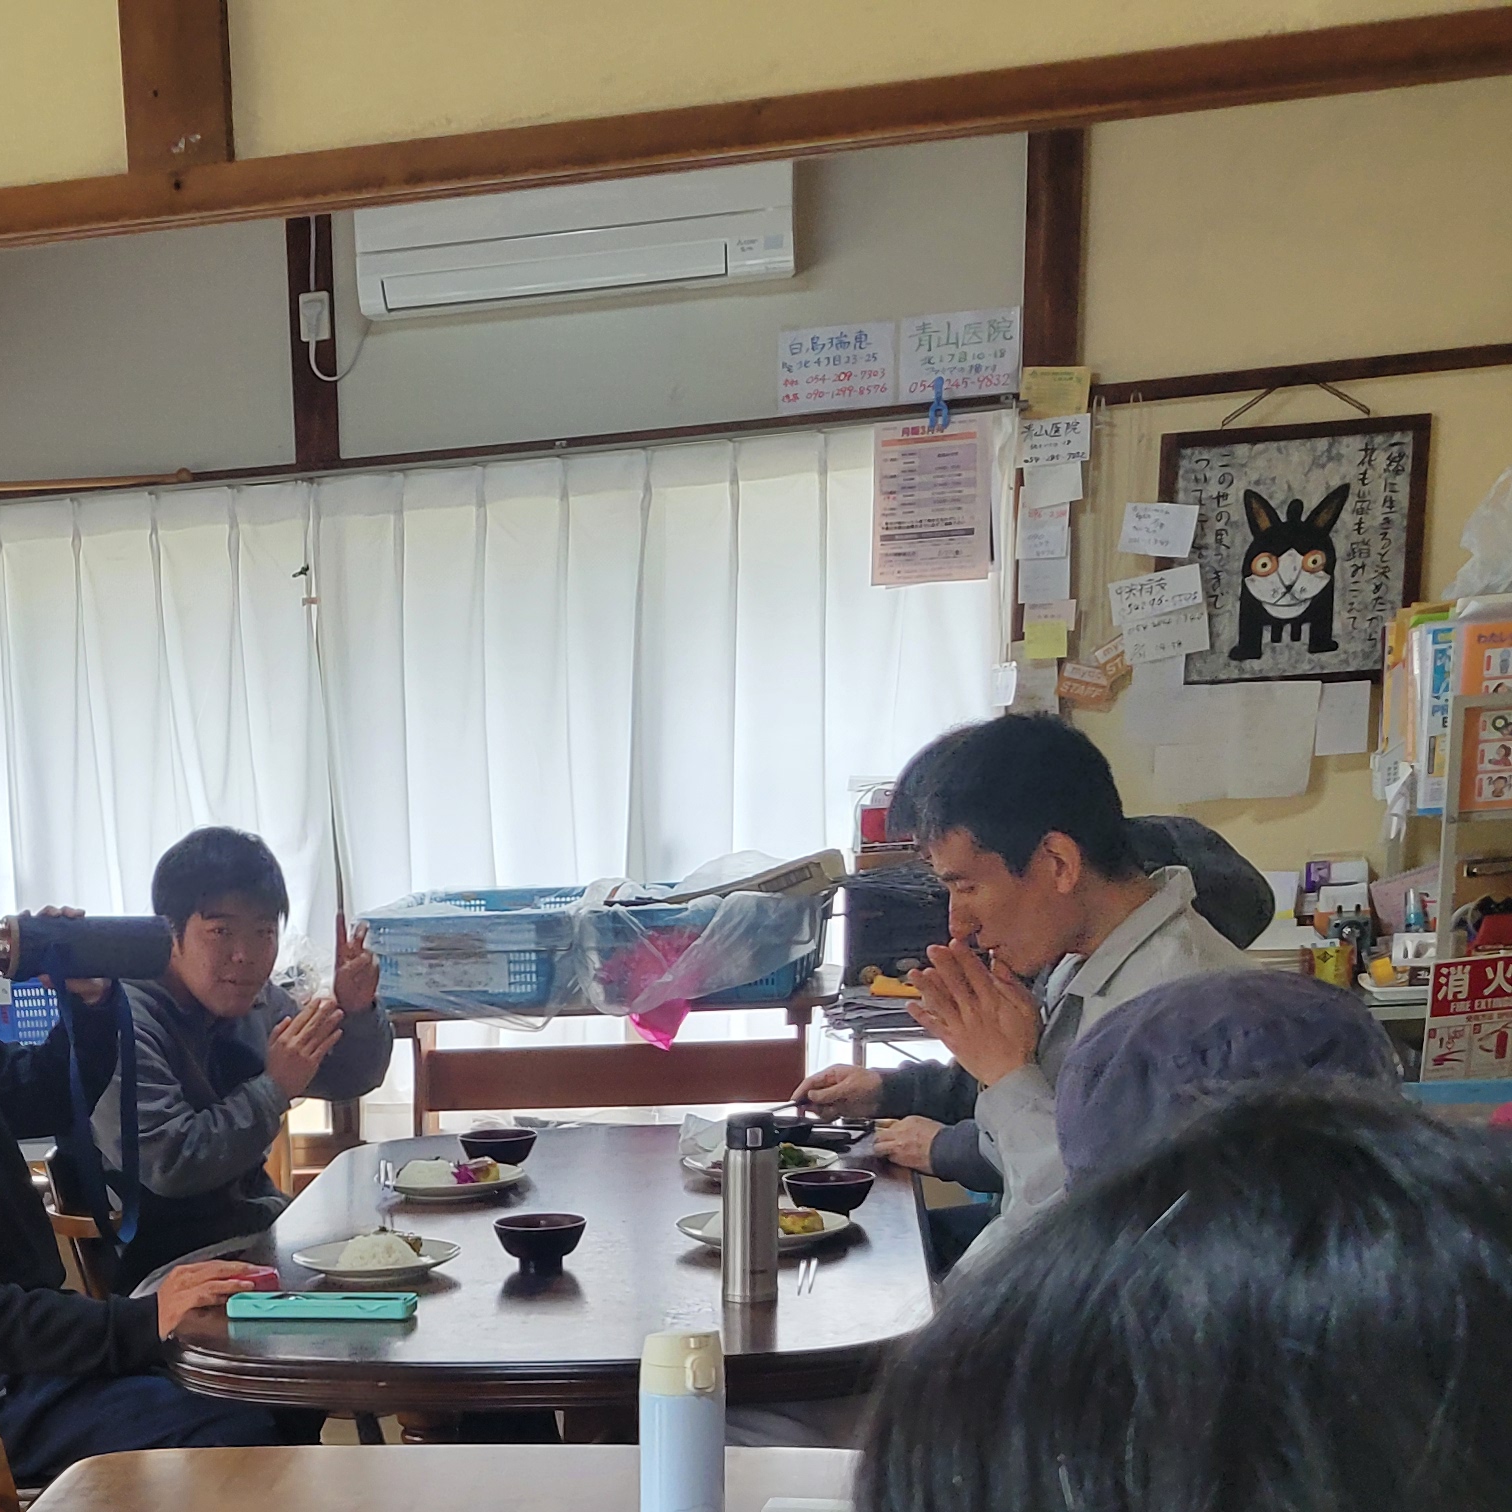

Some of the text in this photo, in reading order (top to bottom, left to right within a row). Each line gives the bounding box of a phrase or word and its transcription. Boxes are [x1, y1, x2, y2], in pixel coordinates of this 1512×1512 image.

[908, 316, 1014, 352] 青山医院
[1059, 680, 1105, 699] STAFF
[1437, 960, 1512, 1000] 消火
